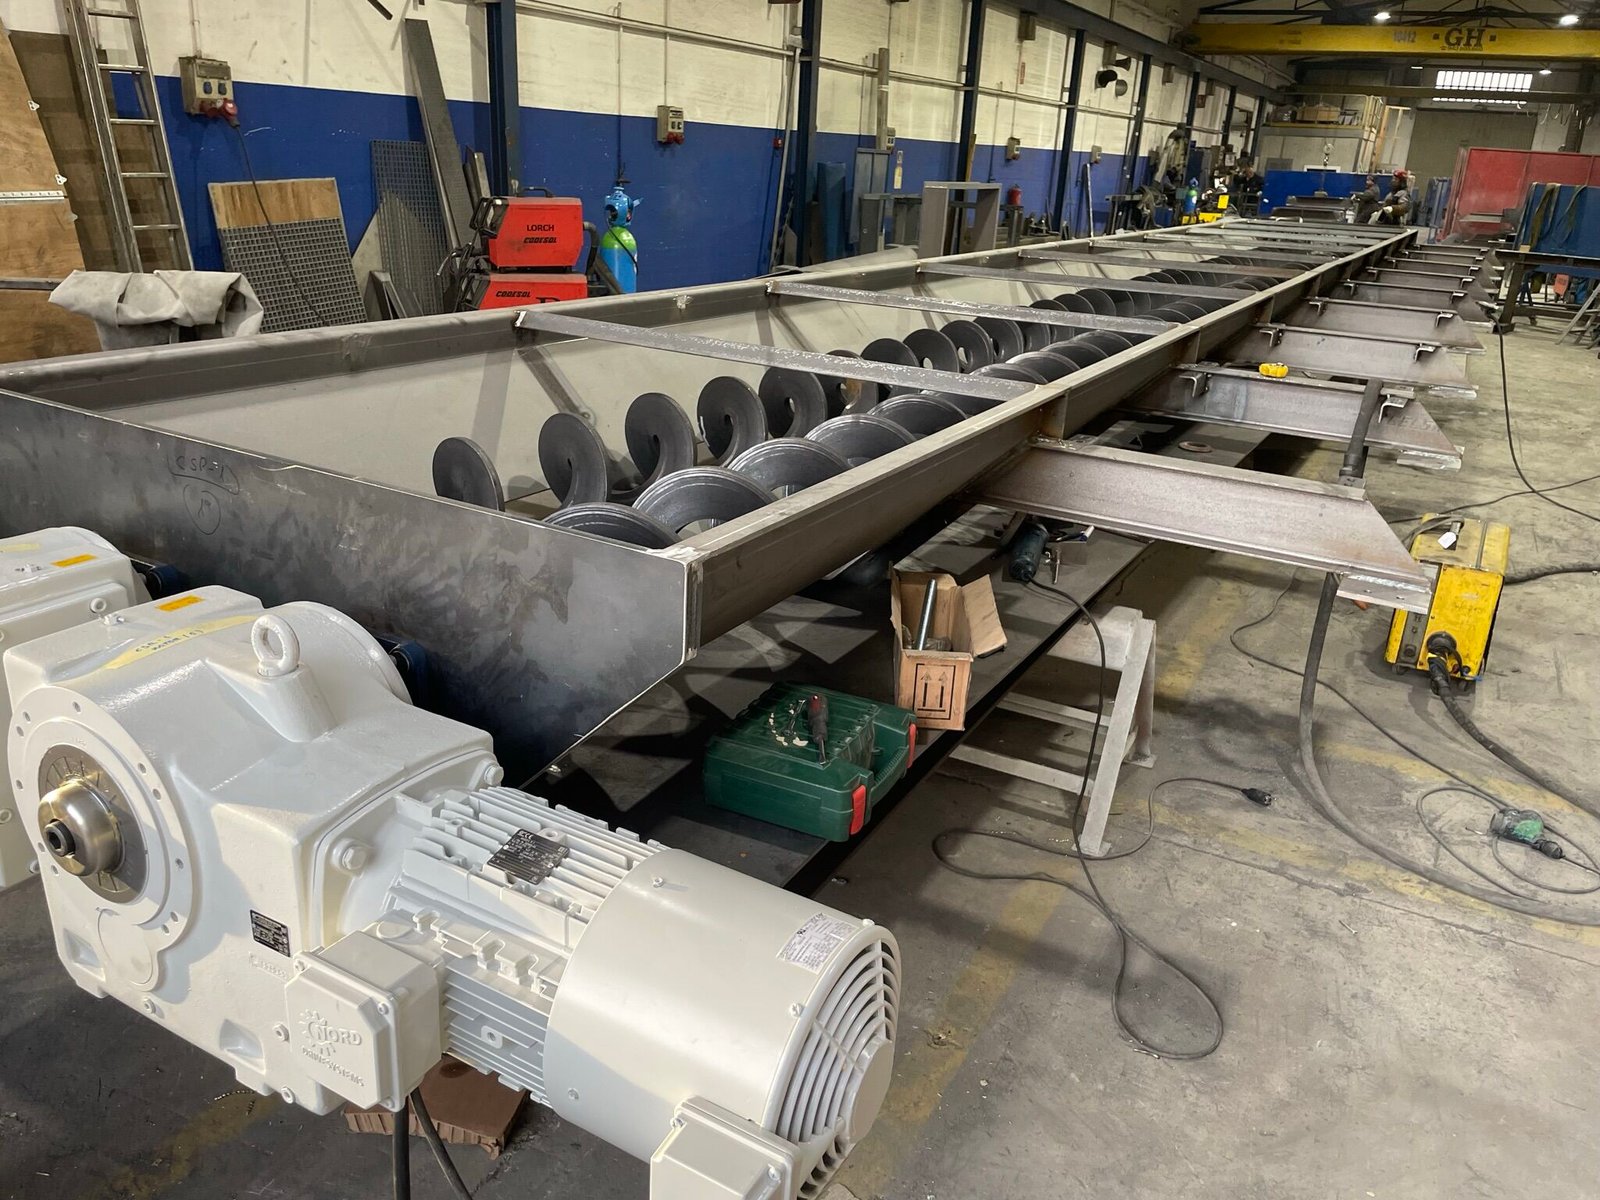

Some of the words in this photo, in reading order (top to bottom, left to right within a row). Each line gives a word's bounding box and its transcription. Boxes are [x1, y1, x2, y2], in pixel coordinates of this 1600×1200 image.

[1444, 27, 1486, 47] GH
[526, 224, 555, 232] LORCH
[523, 236, 557, 244] CODESOL
[495, 290, 531, 298] CODESOL
[315, 1024, 362, 1046] NORD
[302, 1047, 365, 1087] DRIVESYSTEMS
